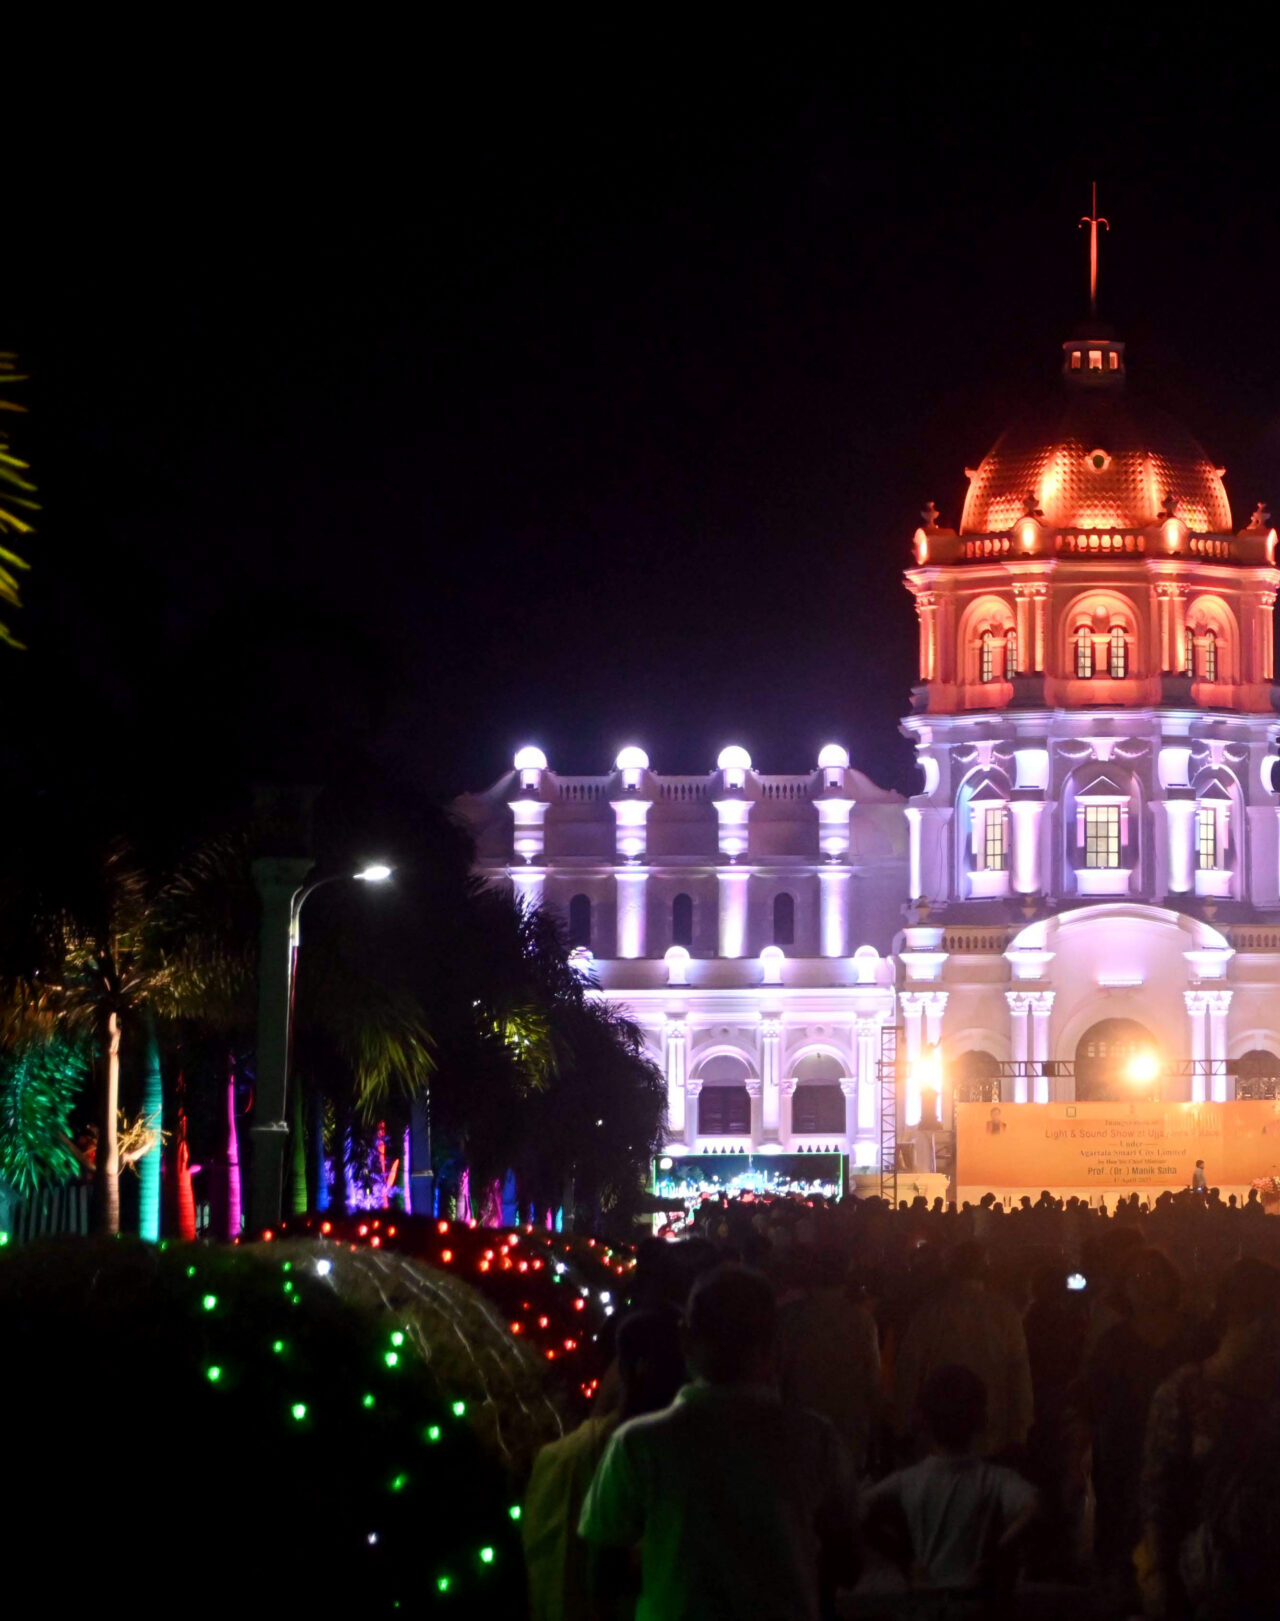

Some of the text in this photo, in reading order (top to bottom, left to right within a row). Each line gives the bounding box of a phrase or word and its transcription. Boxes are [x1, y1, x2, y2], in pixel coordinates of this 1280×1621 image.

[1045, 1128, 1067, 1140] Light
[1070, 1129, 1076, 1138] &
[1079, 1128, 1107, 1138] Sound
[1110, 1129, 1134, 1138] Show
[1119, 1140, 1143, 1148] Under
[1080, 1149, 1111, 1158] Agartala
[1113, 1149, 1136, 1157] Smart
[1131, 1167, 1155, 1175] Manik
[1157, 1166, 1177, 1175] Saha
